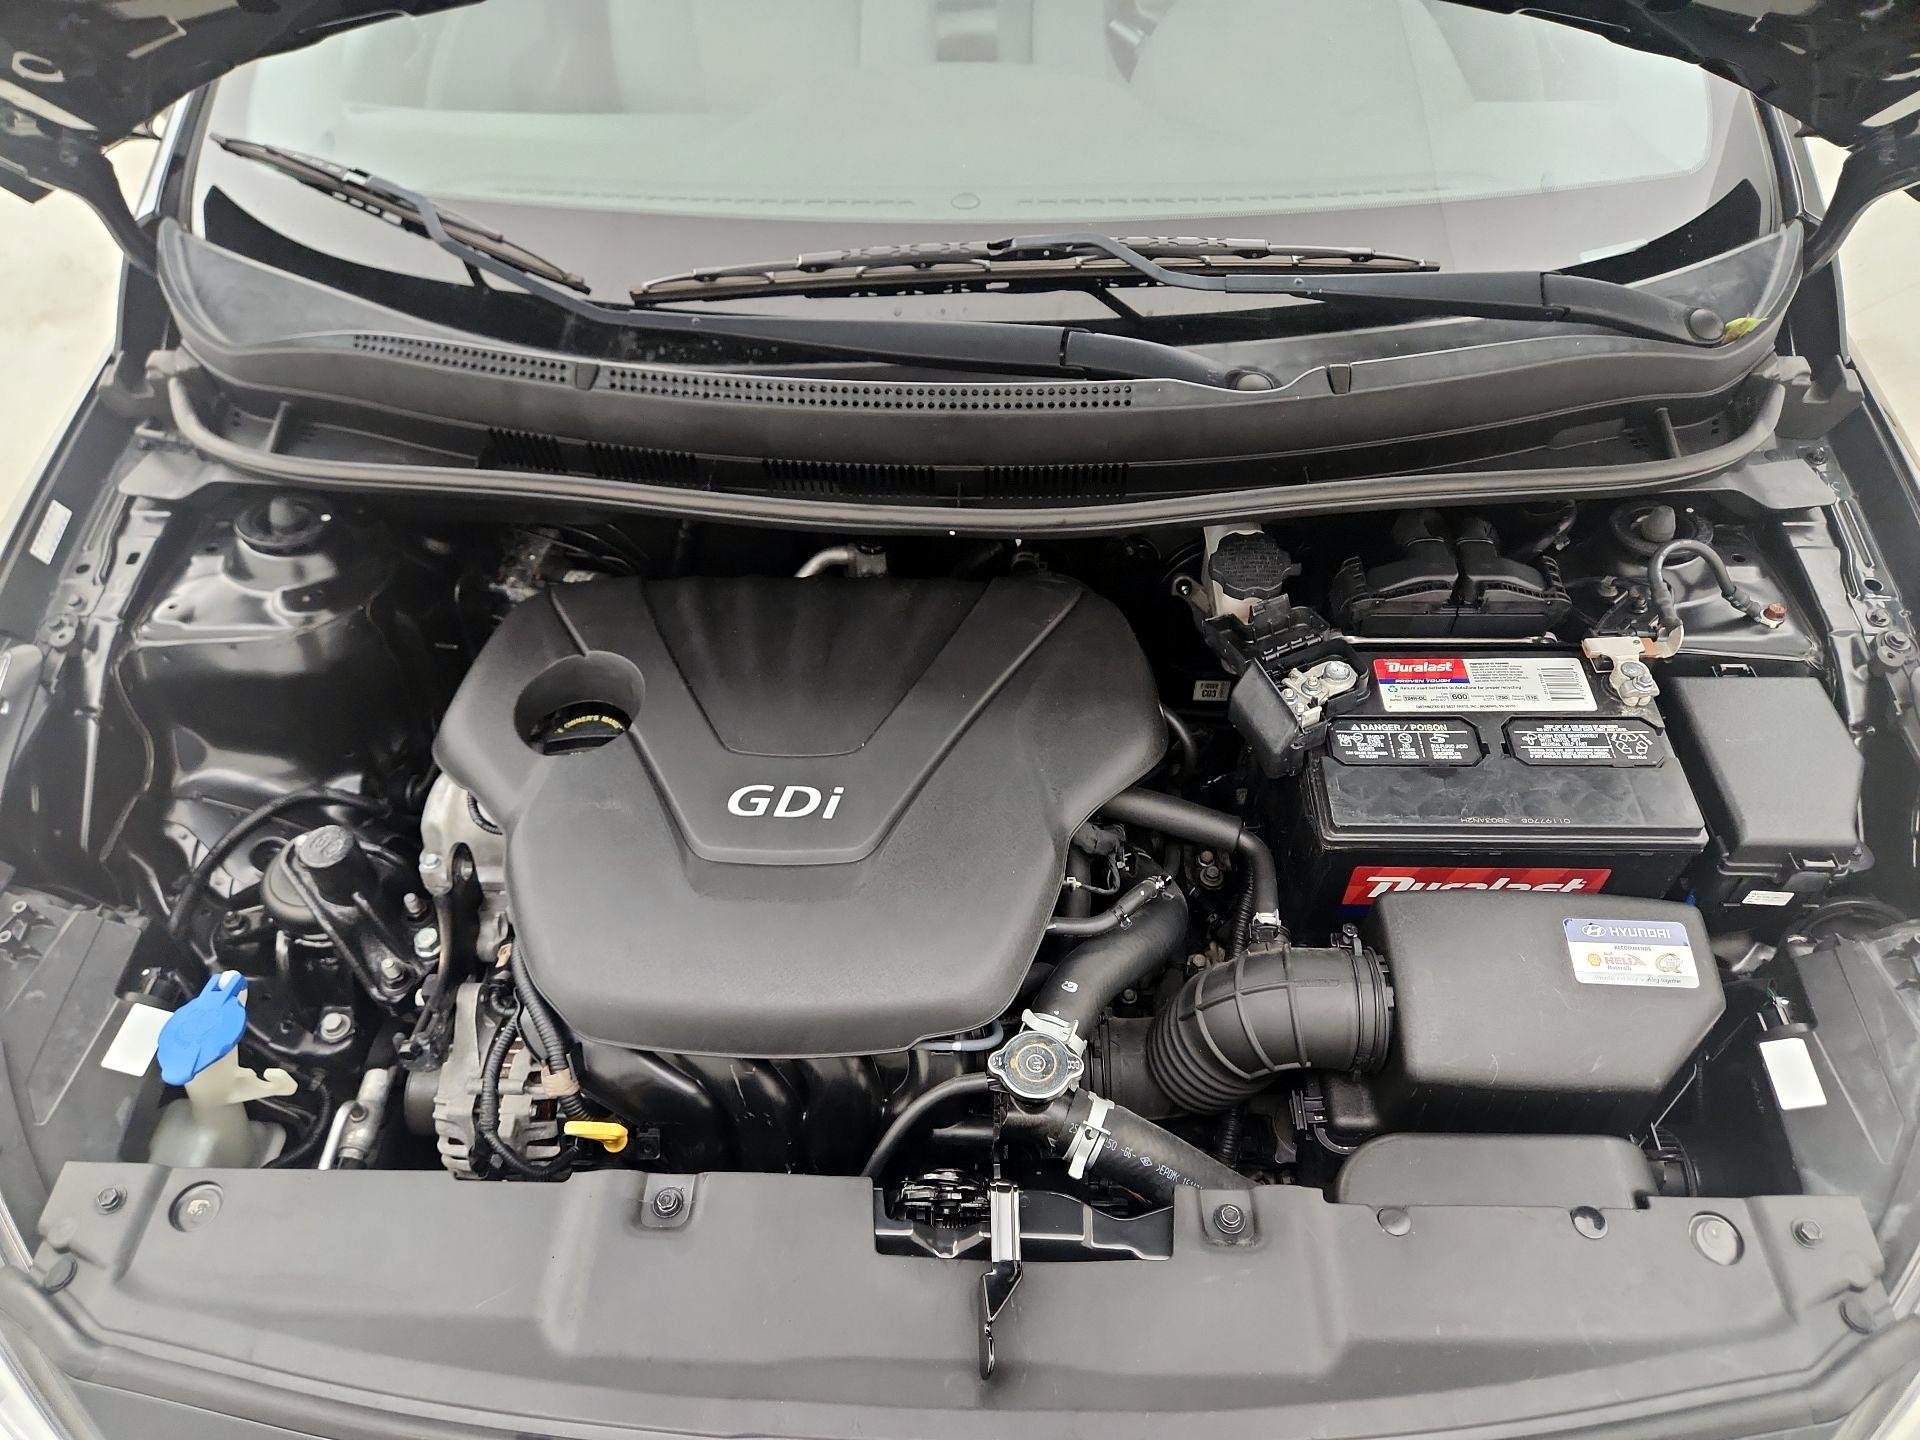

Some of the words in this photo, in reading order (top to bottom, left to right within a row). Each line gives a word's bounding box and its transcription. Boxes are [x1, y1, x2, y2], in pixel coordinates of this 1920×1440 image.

[1384, 661, 1453, 673] Duralast
[727, 784, 845, 820] GDi
[1609, 926, 1672, 939] HYUNDAI
